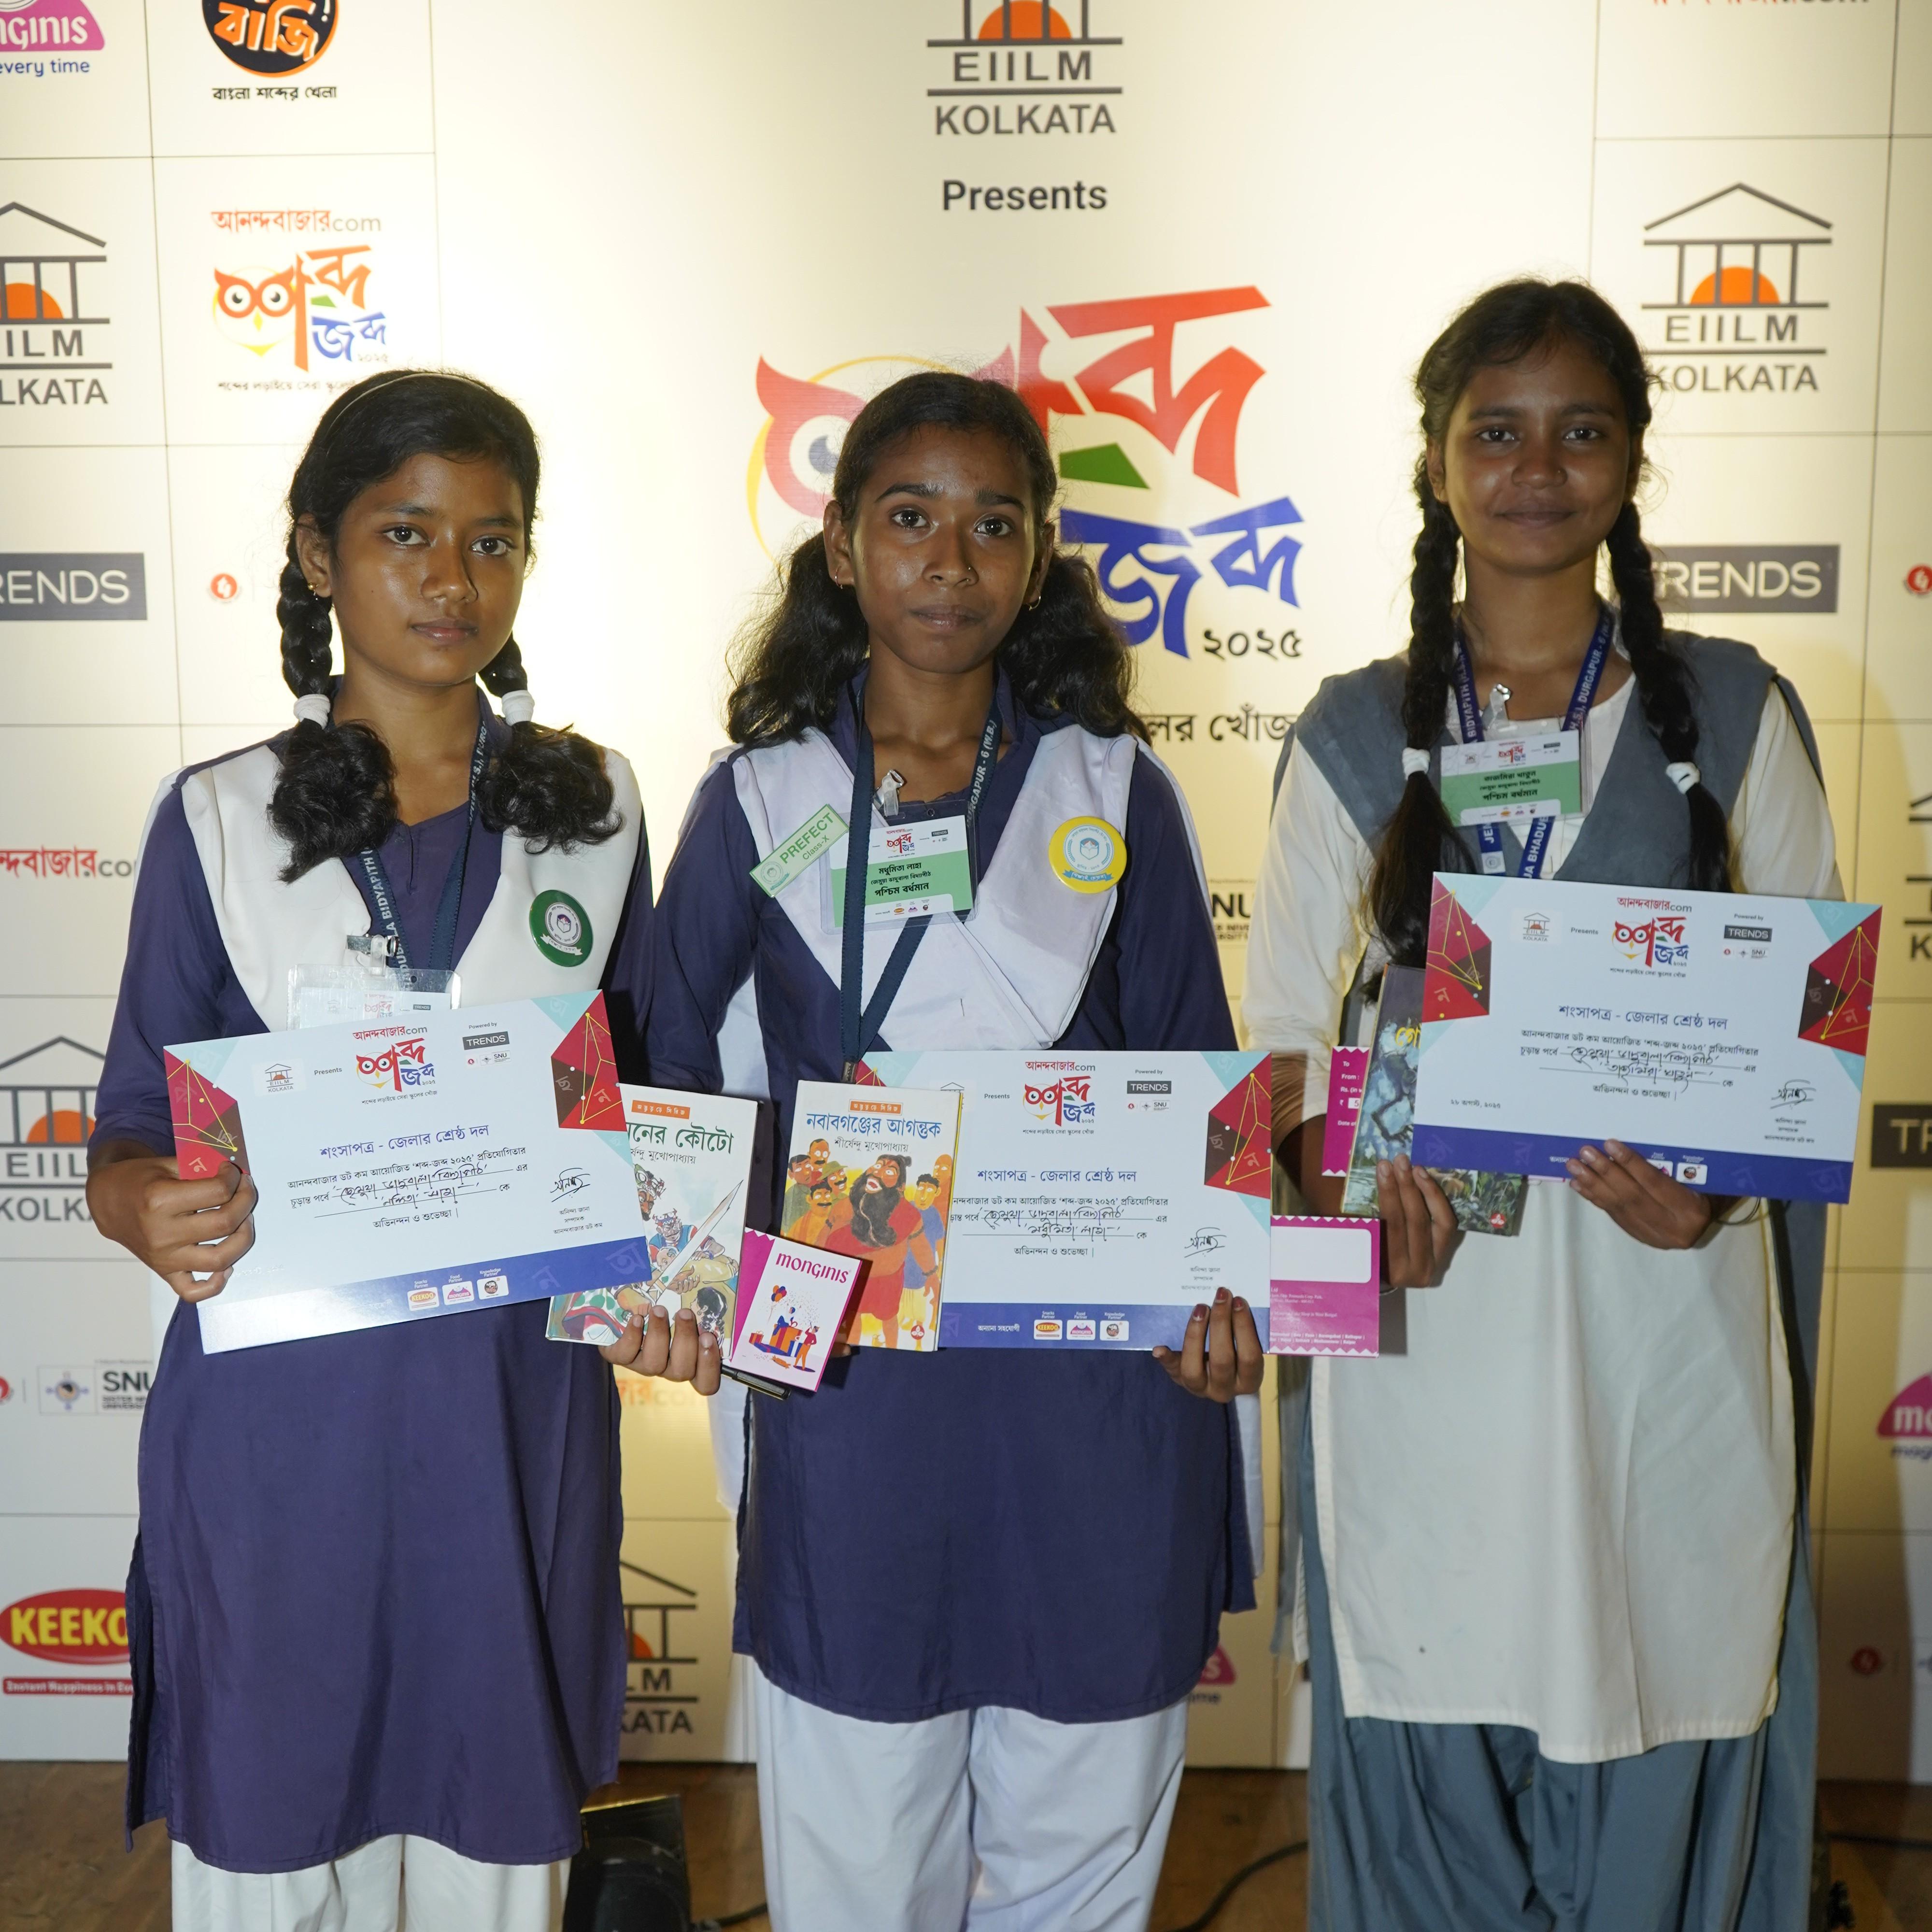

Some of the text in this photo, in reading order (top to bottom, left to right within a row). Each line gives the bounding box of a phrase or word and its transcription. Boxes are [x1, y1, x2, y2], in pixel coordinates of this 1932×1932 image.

[50, 58, 90, 73] time
[953, 50, 1093, 82] EIILM
[212, 87, 250, 100] বাংলা
[305, 86, 337, 98] খেলা
[936, 104, 1116, 135] KOLKATA
[942, 180, 1108, 211] Presents
[1666, 314, 1798, 342] EIILM
[1203, 629, 1304, 661] ২০২৫
[1577, 649, 1603, 703] DURGAPUR
[1482, 788, 1538, 801] পশ্চিম বর্ধমান
[779, 812, 834, 865] PREFECT
[802, 835, 830, 860] Class-X
[878, 864, 905, 877] মধুমিতা
[874, 882, 930, 897] পশ্চিম বর্ধমান
[1570, 927, 1599, 936] Presents
[1728, 928, 1768, 939] TRENDS
[1559, 1005, 1728, 1030] শংসাপত্র জেলার শ্রেষ্ঠ দল
[466, 1034, 506, 1047] TRENDS
[1521, 1029, 1569, 1040] আনন্দবাজার
[1602, 1035, 1640, 1047] আয়োজিত
[1709, 1044, 1759, 1057] প্রতিযোগিতার
[313, 1066, 343, 1076] Presents
[267, 1084, 294, 1094] KOLKATA
[269, 1079, 290, 1087] EIILM
[1130, 1083, 1169, 1092] TRENDS
[1593, 1084, 1629, 1095] অভিনন্দন
[806, 1112, 942, 1139] নবাবগঞ্জের আগন্তুক
[319, 1125, 489, 1159] শংসাপত্র জেলার শ্রেষ্ঠ দল
[676, 1122, 734, 1154] কৌটো
[834, 1136, 909, 1153] শীর্ষেন্দু মুখোপাধ্যায়
[6, 1152, 88, 1178] EIIL
[649, 1151, 696, 1165] মুখোপাধ্যায়
[287, 1175, 337, 1190] আনন্দবাজার
[339, 1172, 353, 1183] ডট
[355, 1171, 368, 1180] কম
[369, 1163, 410, 1178] আয়োজিত
[477, 1146, 526, 1161] প্রতিযোগিতার
[515, 1163, 528, 1173] এর
[977, 1167, 1137, 1182] শংসাপত্র জেলার শ্রেষ্ঠ দল
[499, 1183, 511, 1192] কে
[290, 1192, 329, 1209] চূড়ান্ত পর্বে
[991, 1196, 1003, 1206] ডট
[1019, 1196, 1057, 1206] আয়োজিত
[1120, 1196, 1168, 1208] প্রতিযোগিতার
[372, 1209, 453, 1229] অভিনন্দন ও শুভেচ্ছা
[964, 1211, 980, 1221] পর্বে
[1155, 1215, 1167, 1223] এর
[553, 1225, 584, 1235] আনন্দবাজার
[1136, 1232, 1148, 1240] কে
[1014, 1247, 1049, 1256] অভিনন্দন
[1060, 1248, 1088, 1256] শুভেচ্ছা
[411, 1293, 434, 1301] KEEKOO
